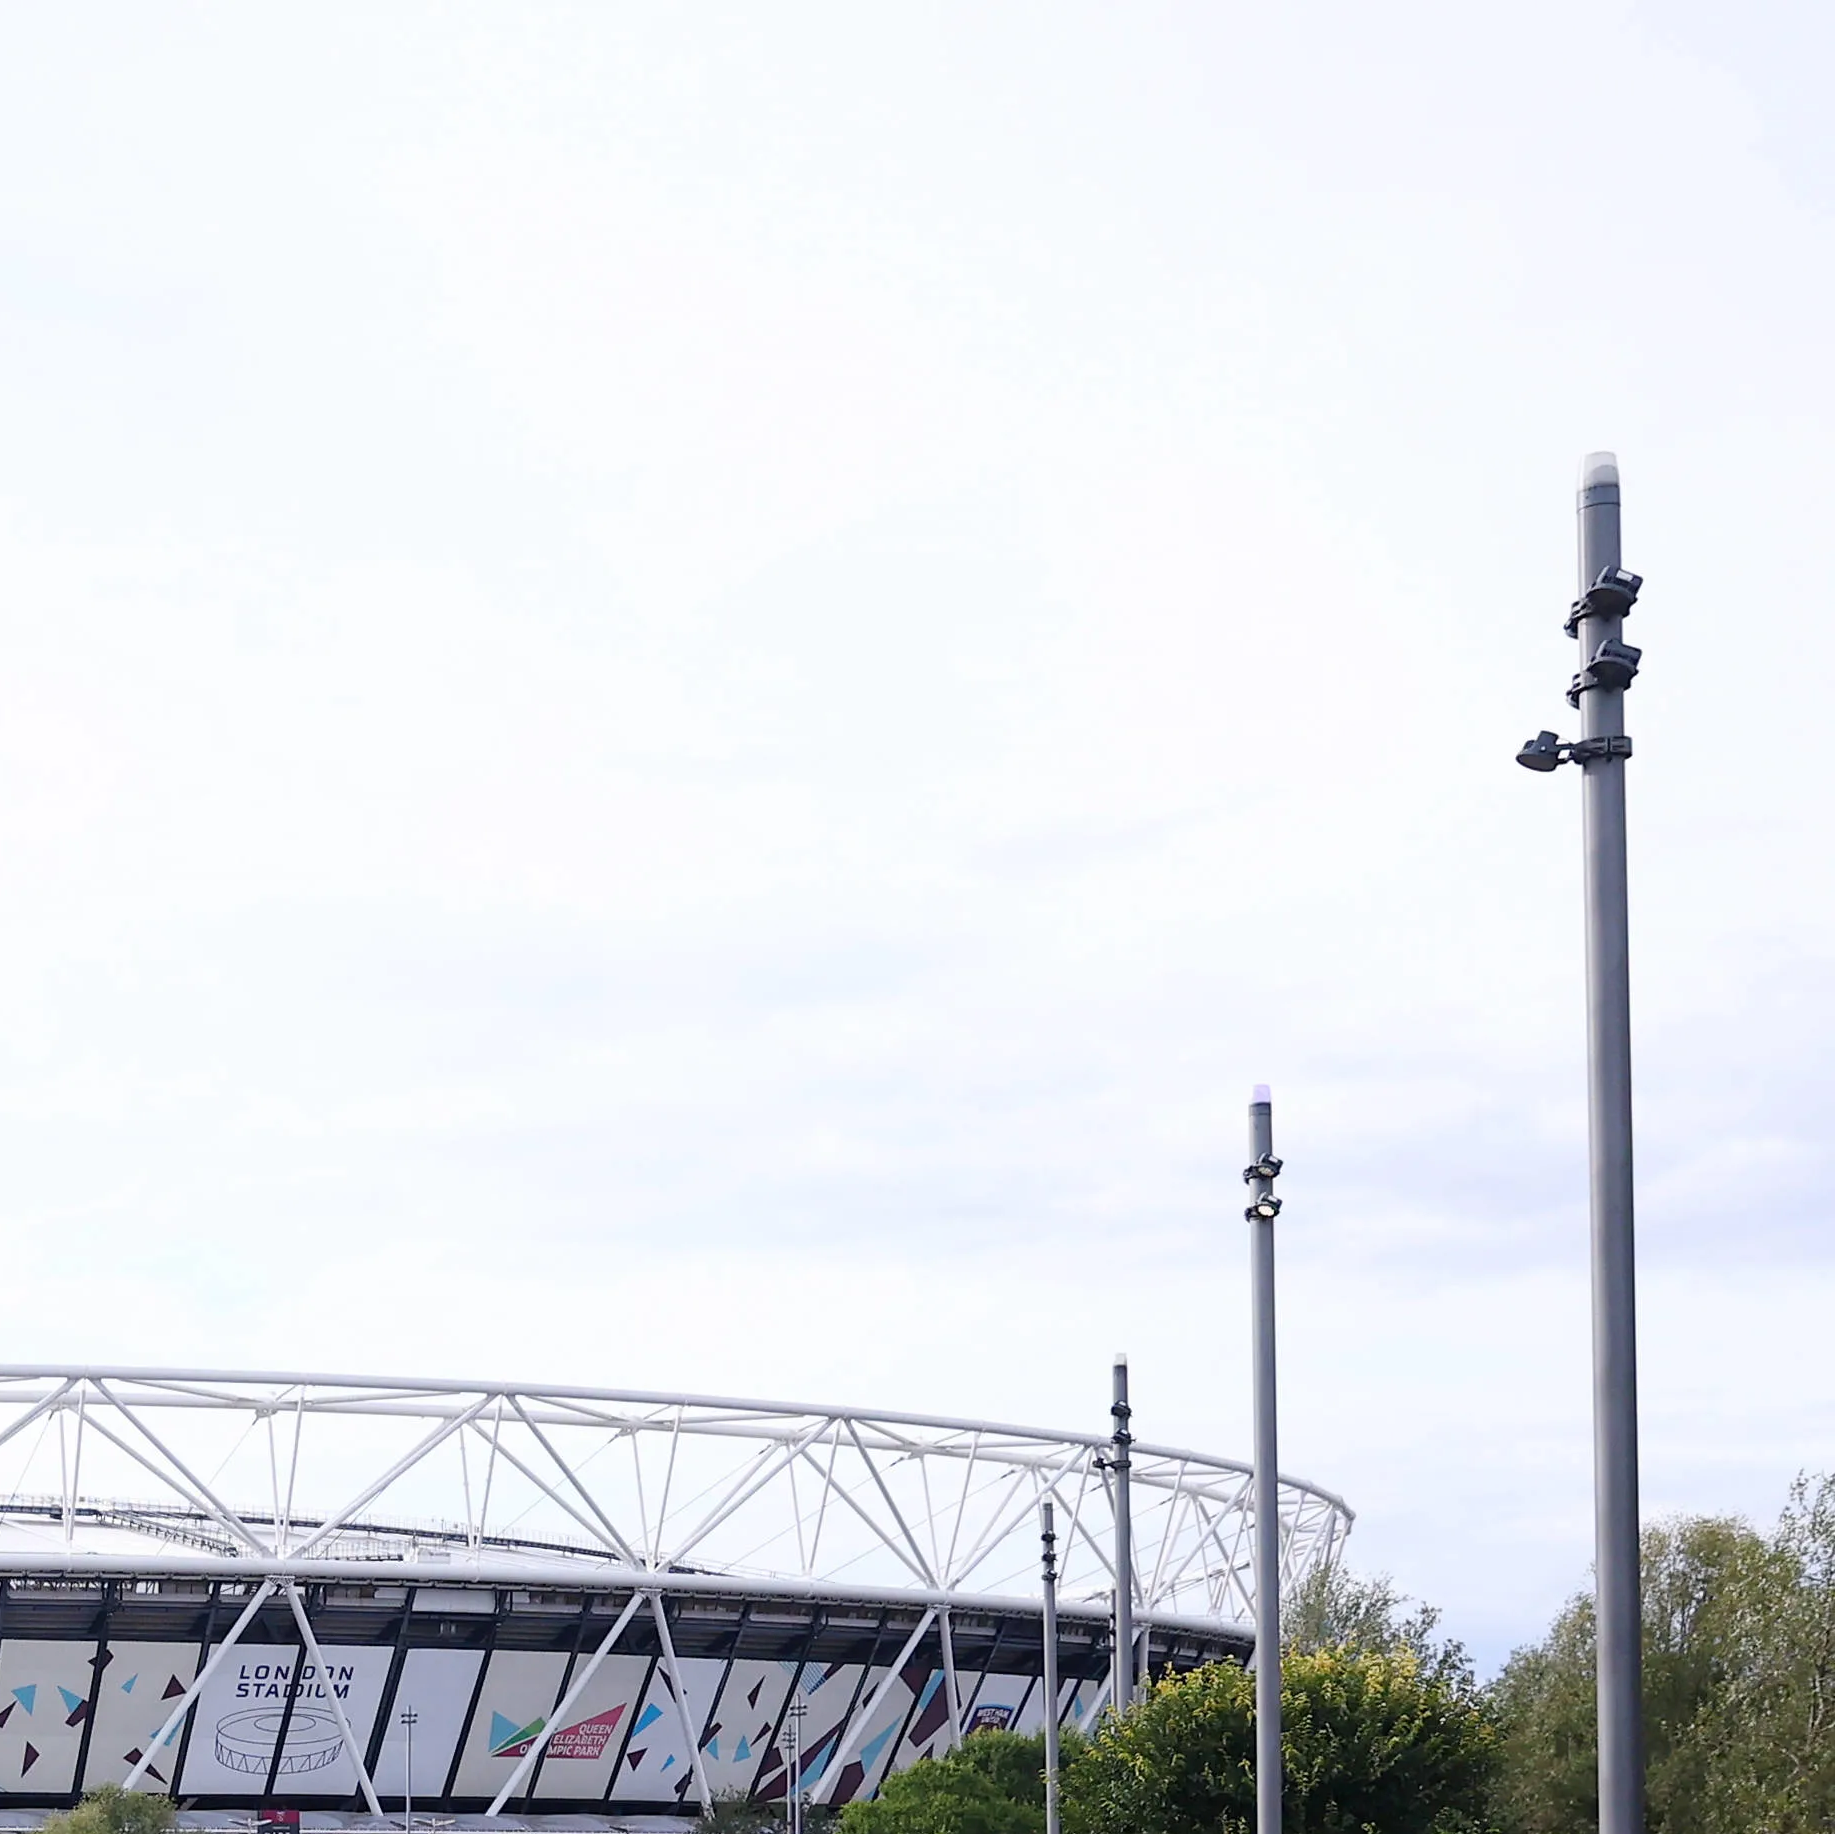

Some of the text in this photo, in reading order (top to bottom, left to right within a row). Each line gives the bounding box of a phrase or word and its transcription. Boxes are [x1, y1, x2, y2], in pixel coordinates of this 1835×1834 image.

[236, 1683, 350, 1699] STADIUM
[579, 1724, 614, 1735] QUEEN
[553, 1735, 607, 1745] ELIZABETH
[520, 1744, 601, 1756] OMPIC PARK
